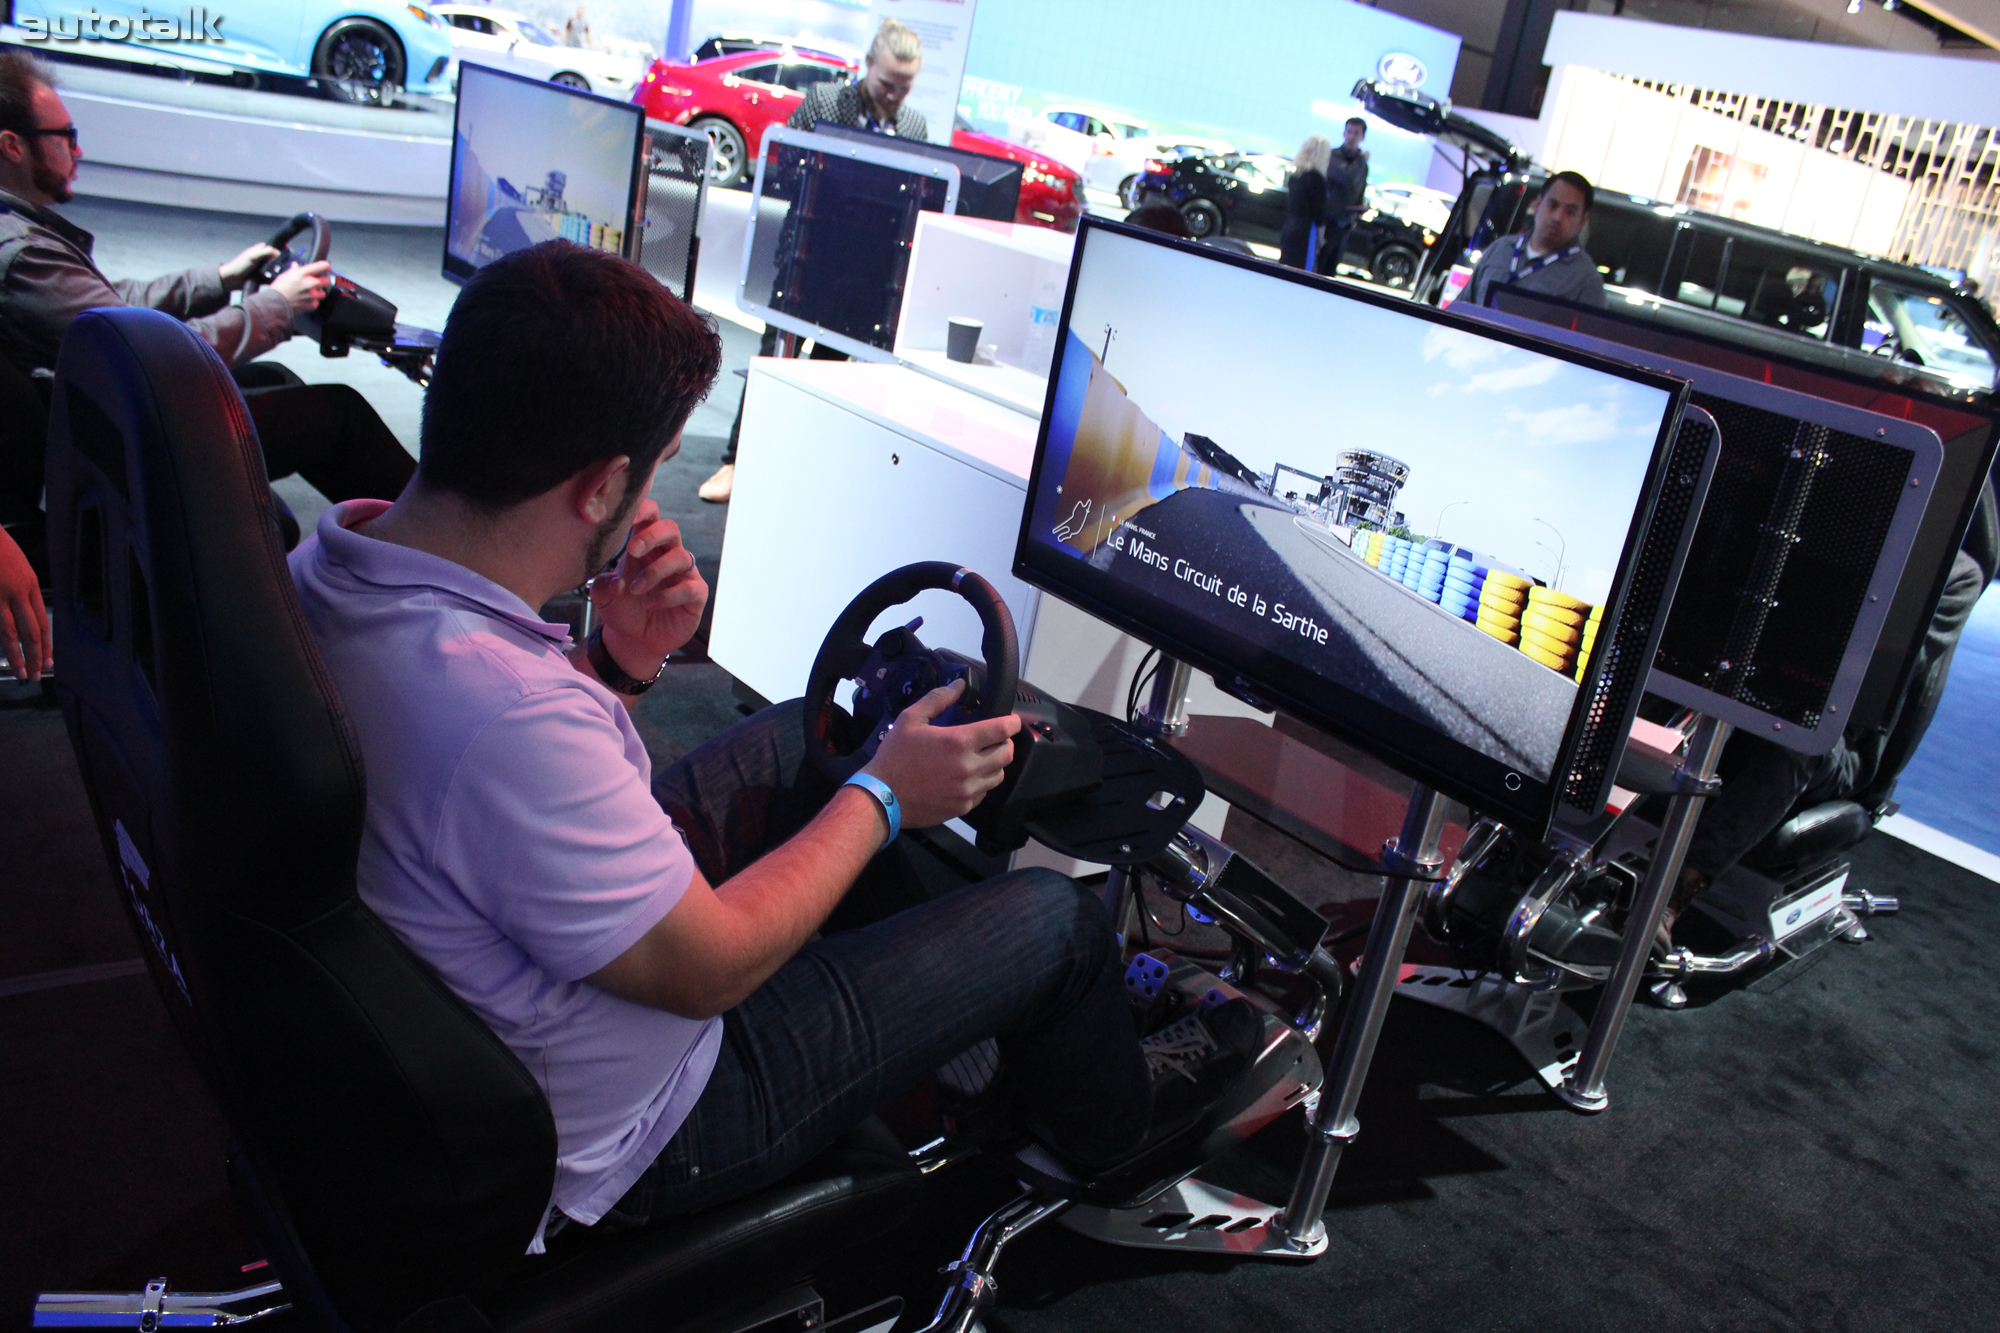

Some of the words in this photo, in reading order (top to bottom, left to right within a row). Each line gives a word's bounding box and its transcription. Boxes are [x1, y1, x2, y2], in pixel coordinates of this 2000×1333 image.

[1139, 527, 1156, 540] FRANCE
[1106, 527, 1125, 551] Le
[1128, 537, 1170, 572] Mans
[1174, 558, 1223, 597] Circuit
[1226, 584, 1248, 609] de
[1251, 594, 1267, 617] la
[1271, 603, 1329, 646] Sarthe
